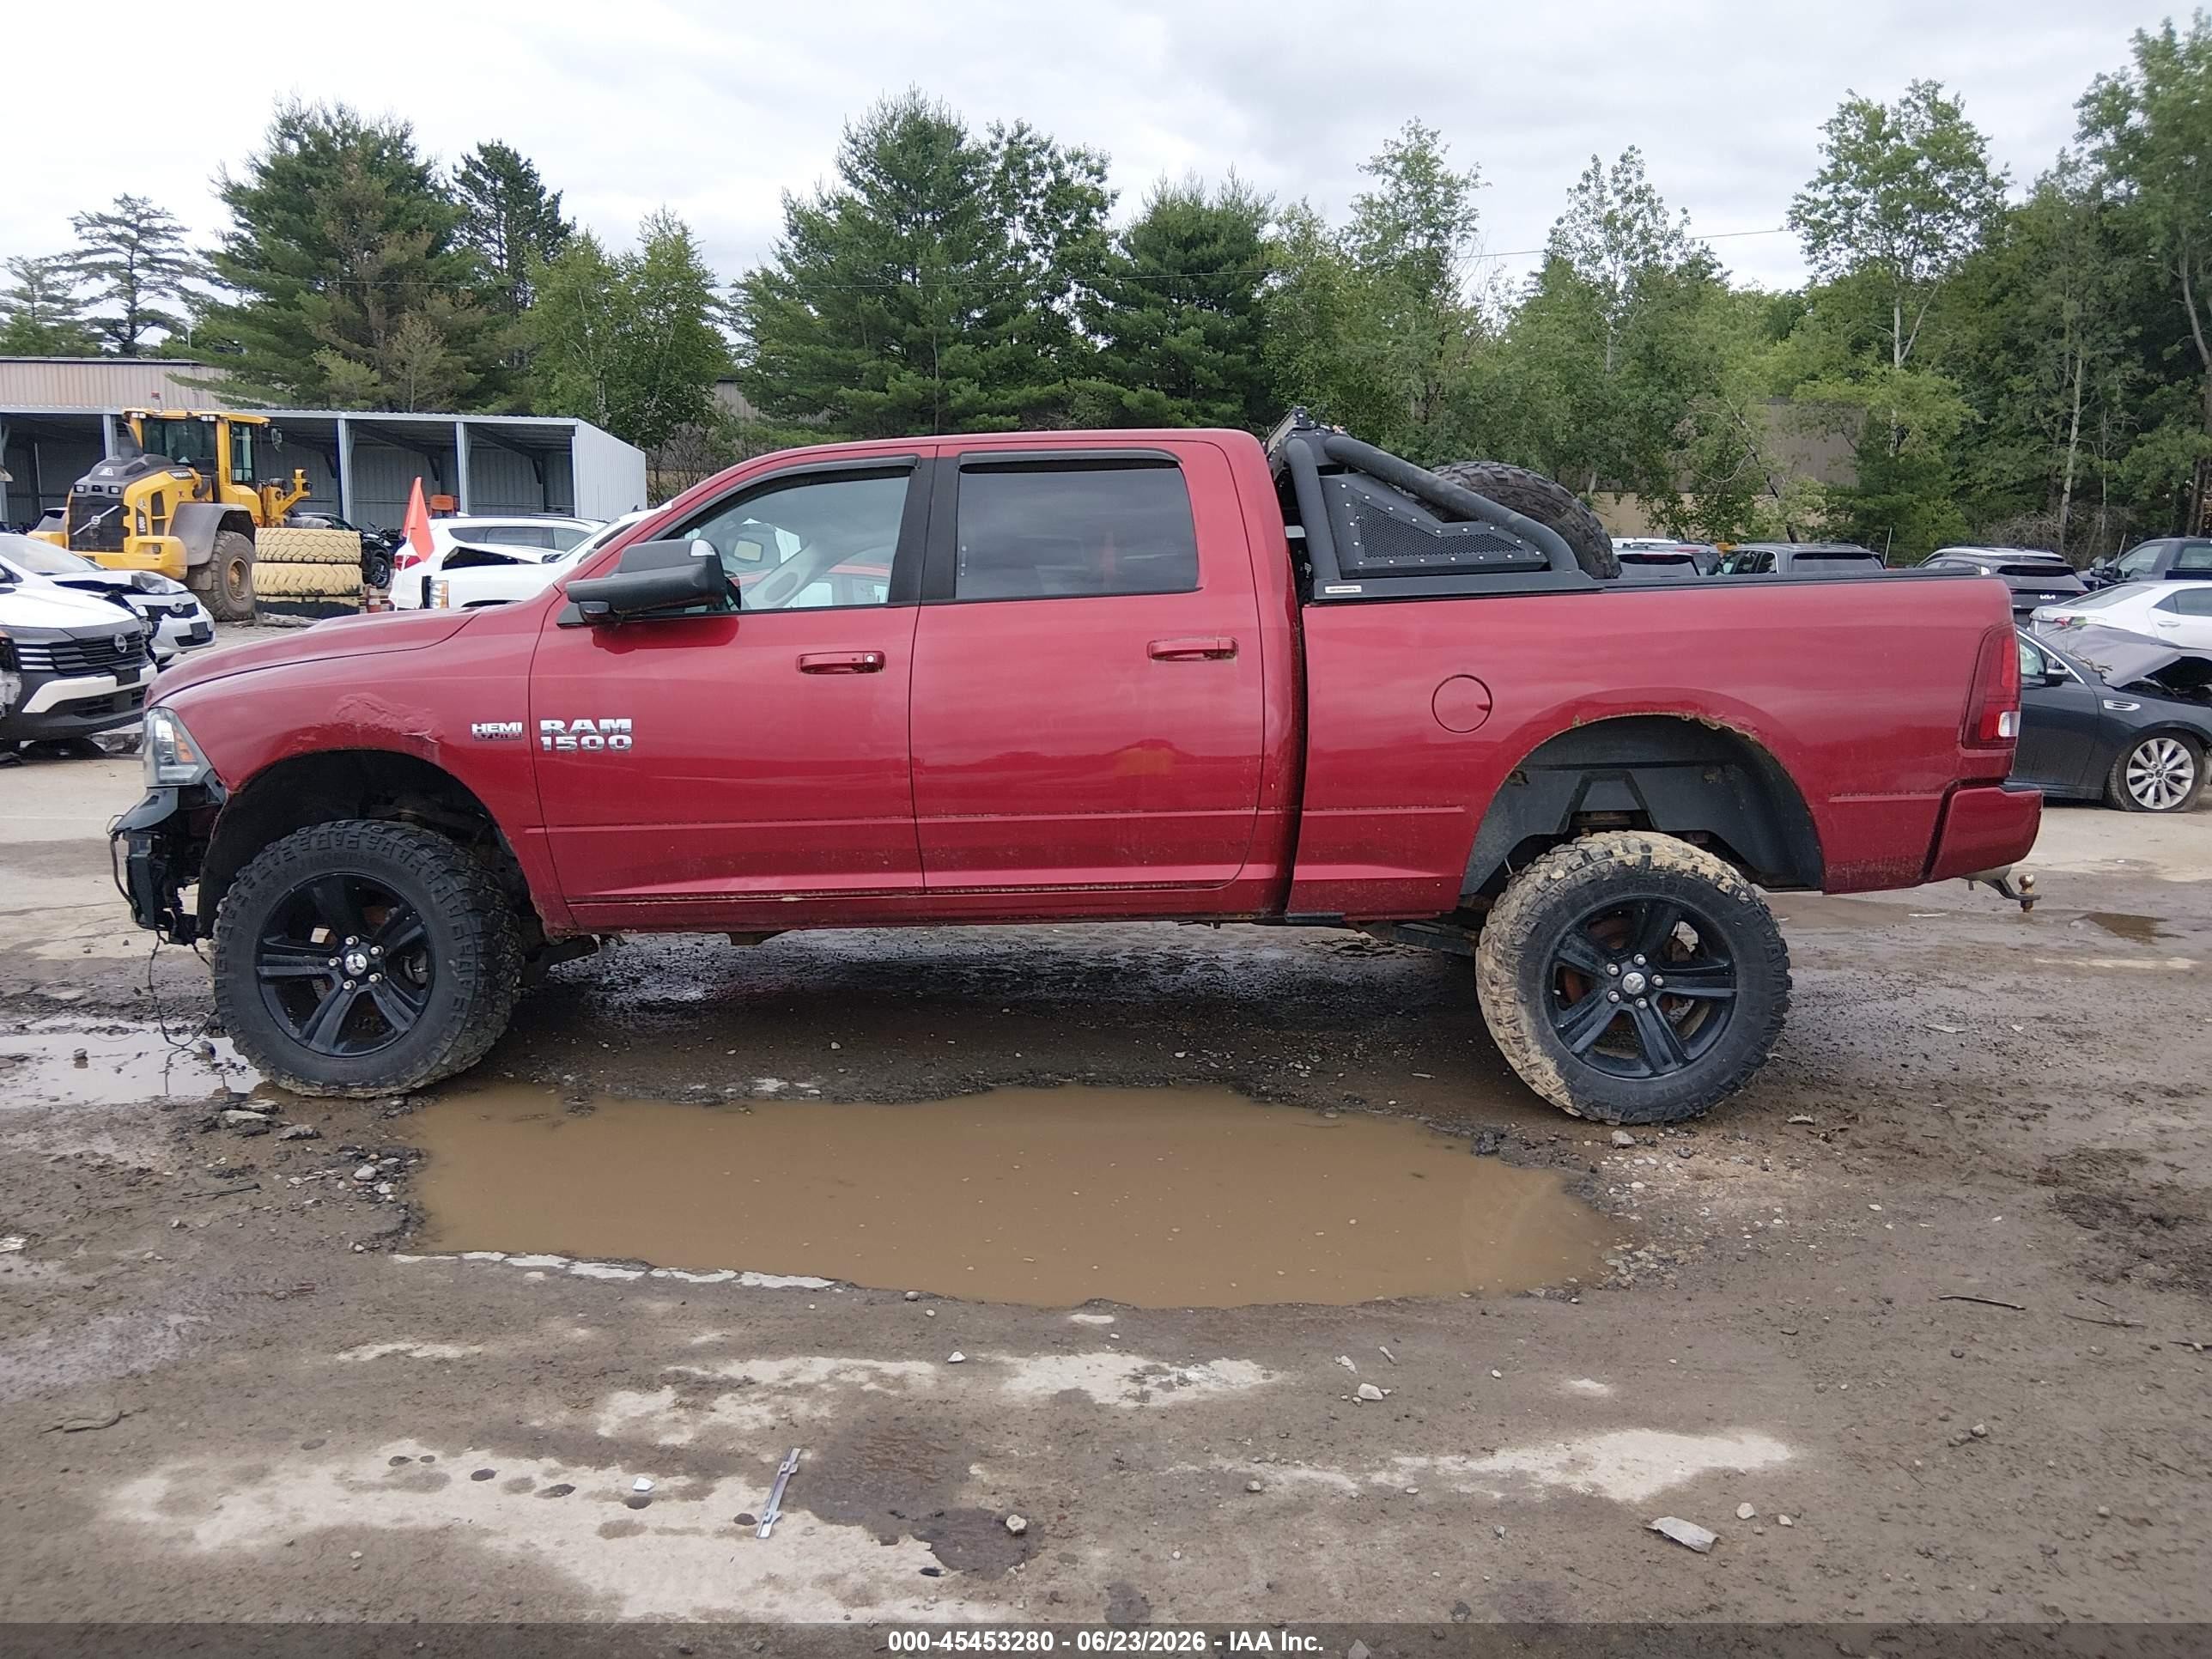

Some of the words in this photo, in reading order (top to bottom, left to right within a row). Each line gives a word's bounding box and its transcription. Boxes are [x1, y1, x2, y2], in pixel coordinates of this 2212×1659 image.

[471, 722, 523, 732] HEMI
[539, 719, 633, 734] RAM
[540, 735, 633, 751] 1500
